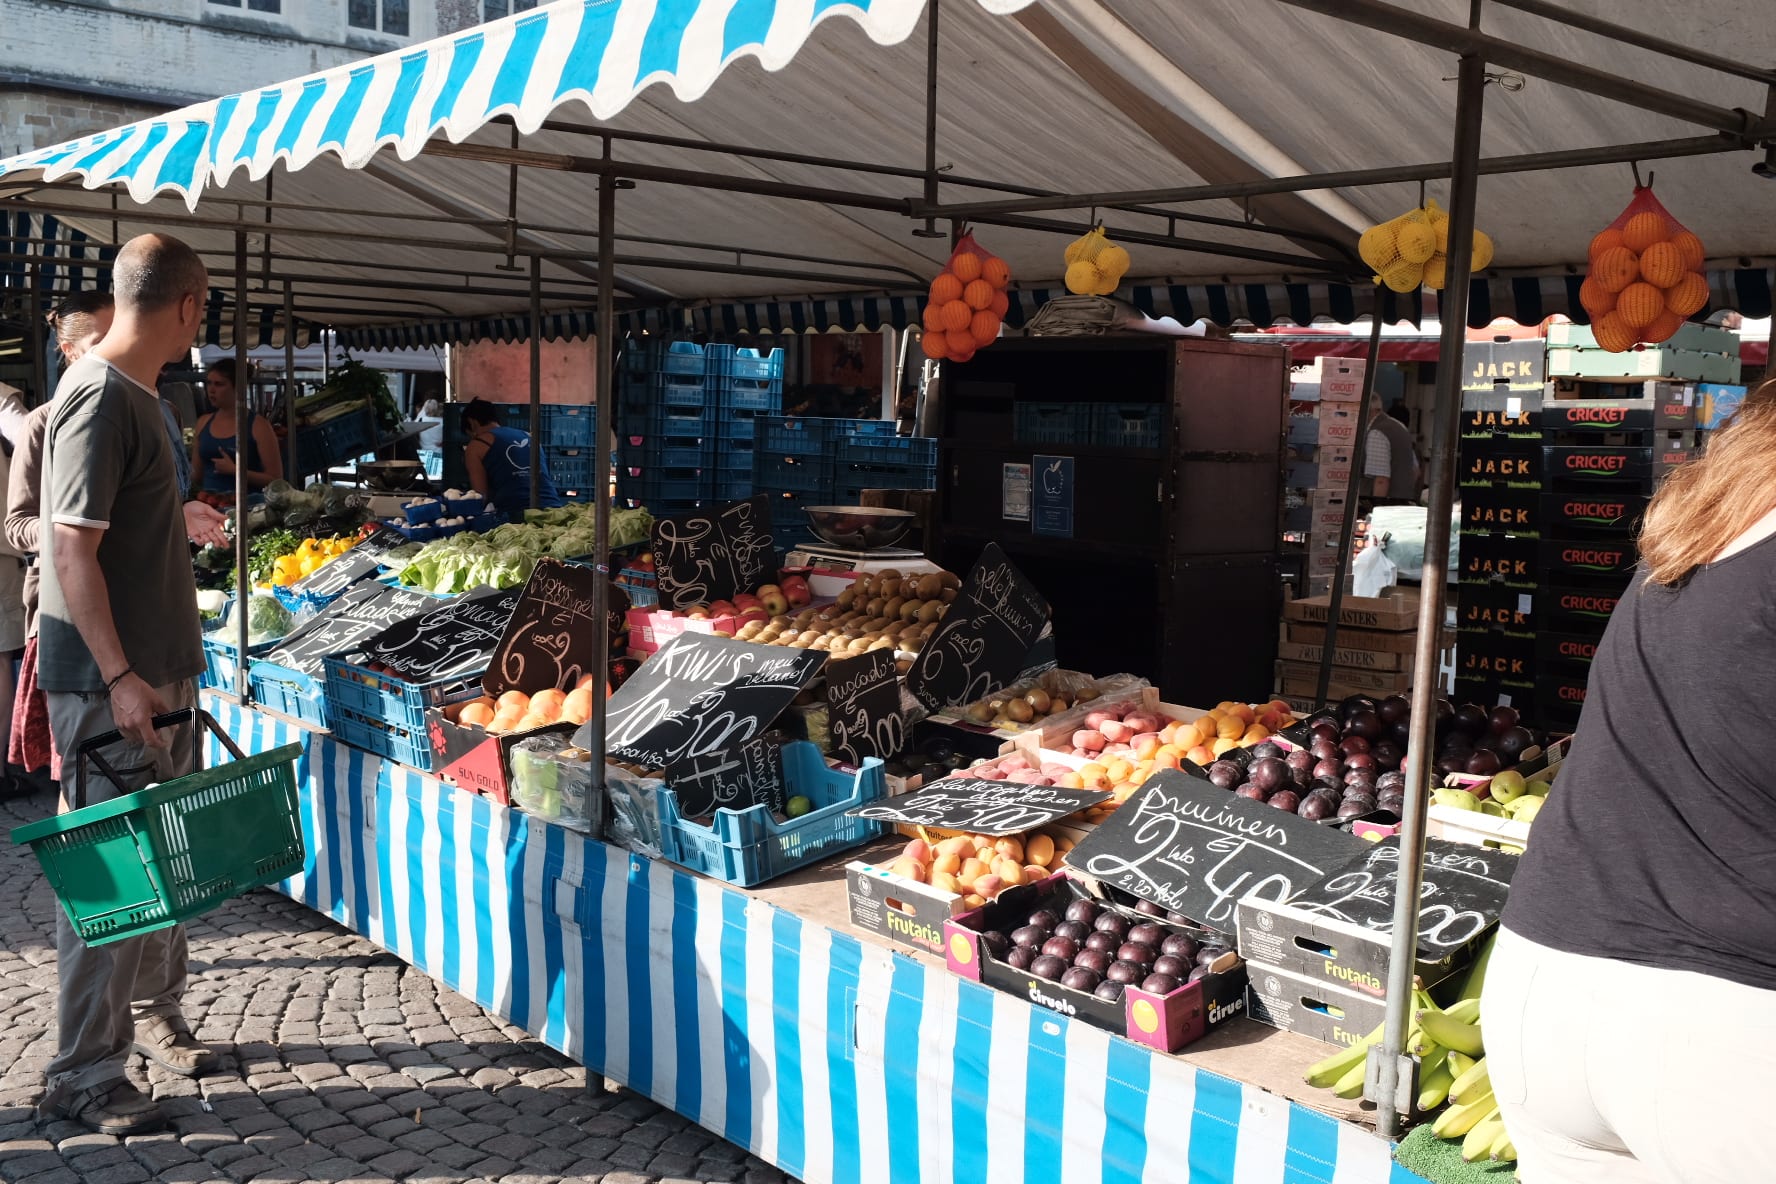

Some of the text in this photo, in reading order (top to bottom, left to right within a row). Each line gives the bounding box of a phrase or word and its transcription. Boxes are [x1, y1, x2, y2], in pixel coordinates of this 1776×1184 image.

[1473, 361, 1532, 378] JACK
[1329, 383, 1356, 393] CRICKET
[1472, 410, 1530, 426] JACK
[1566, 407, 1629, 422] CRICKET
[1664, 405, 1688, 415] CRICKET
[1471, 458, 1529, 475] JACK
[1565, 455, 1627, 470] CRICKET
[1663, 453, 1687, 464] CRICKET
[1327, 470, 1350, 480] CRICKE
[1470, 506, 1528, 523] JACK
[1563, 502, 1625, 517] CRICKET
[1562, 549, 1622, 565] CRICKET
[1469, 557, 1527, 575] JACK
[1303, 605, 1377, 626] FRUIASTERS
[1467, 605, 1526, 623] JACK
[501, 620, 538, 685] 6
[922, 619, 968, 681] 6
[1559, 642, 1598, 657] CRIC
[1465, 653, 1525, 674] JACK
[605, 678, 670, 747] 10
[458, 767, 499, 791] SUN GOLD
[886, 910, 942, 945] Frutaria
[1324, 960, 1382, 990] Frutaria
